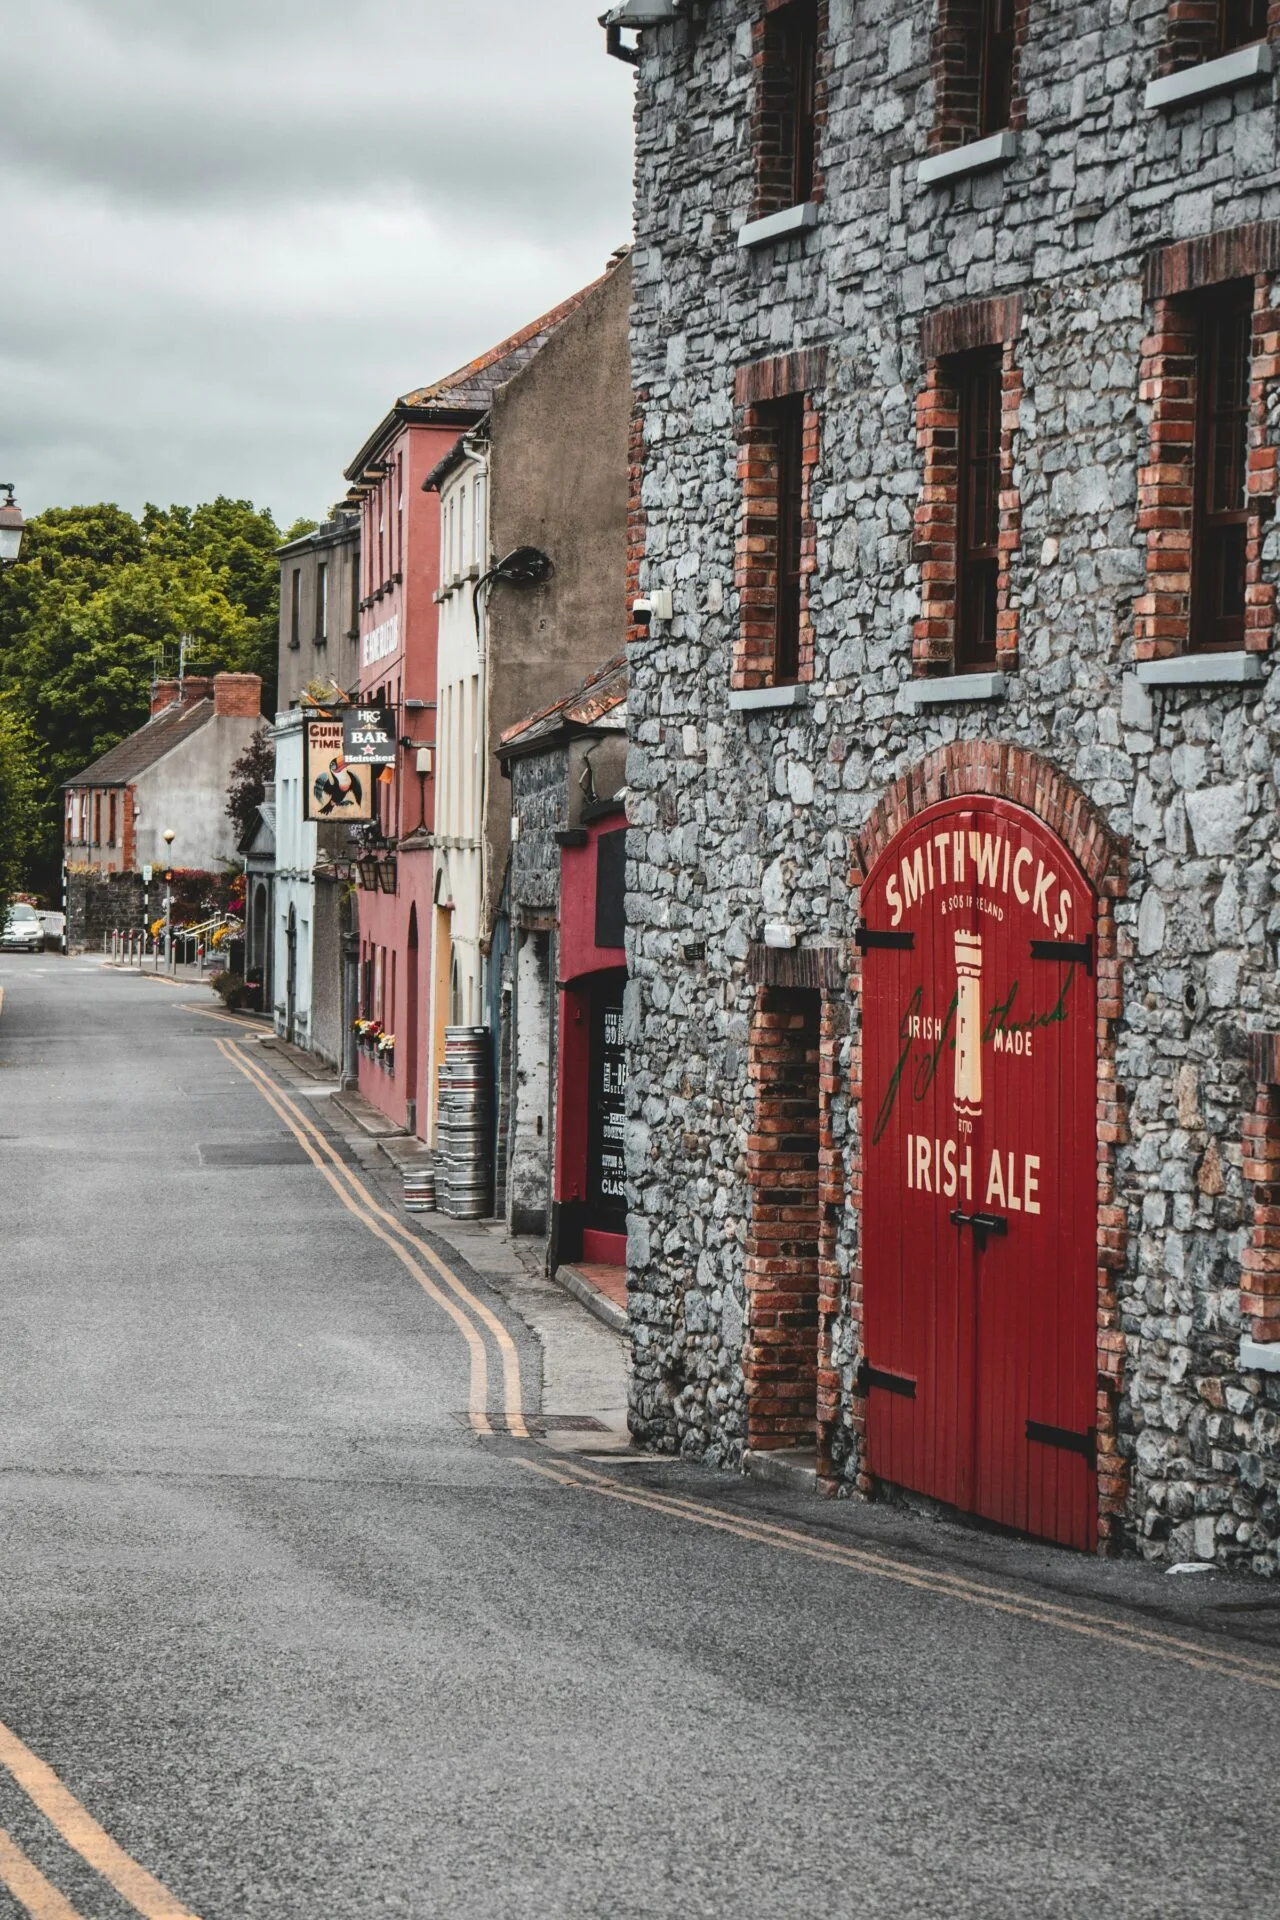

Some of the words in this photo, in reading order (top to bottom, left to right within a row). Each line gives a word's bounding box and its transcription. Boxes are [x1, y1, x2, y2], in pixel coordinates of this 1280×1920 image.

[351, 731, 389, 744] BAR
[344, 754, 396, 763] Heineken
[908, 1015, 942, 1040] IRISH
[993, 1028, 1033, 1056] MADE
[907, 1134, 972, 1201] IRISH
[601, 1178, 625, 1196] CLAS
[985, 1148, 1041, 1215] ALE
